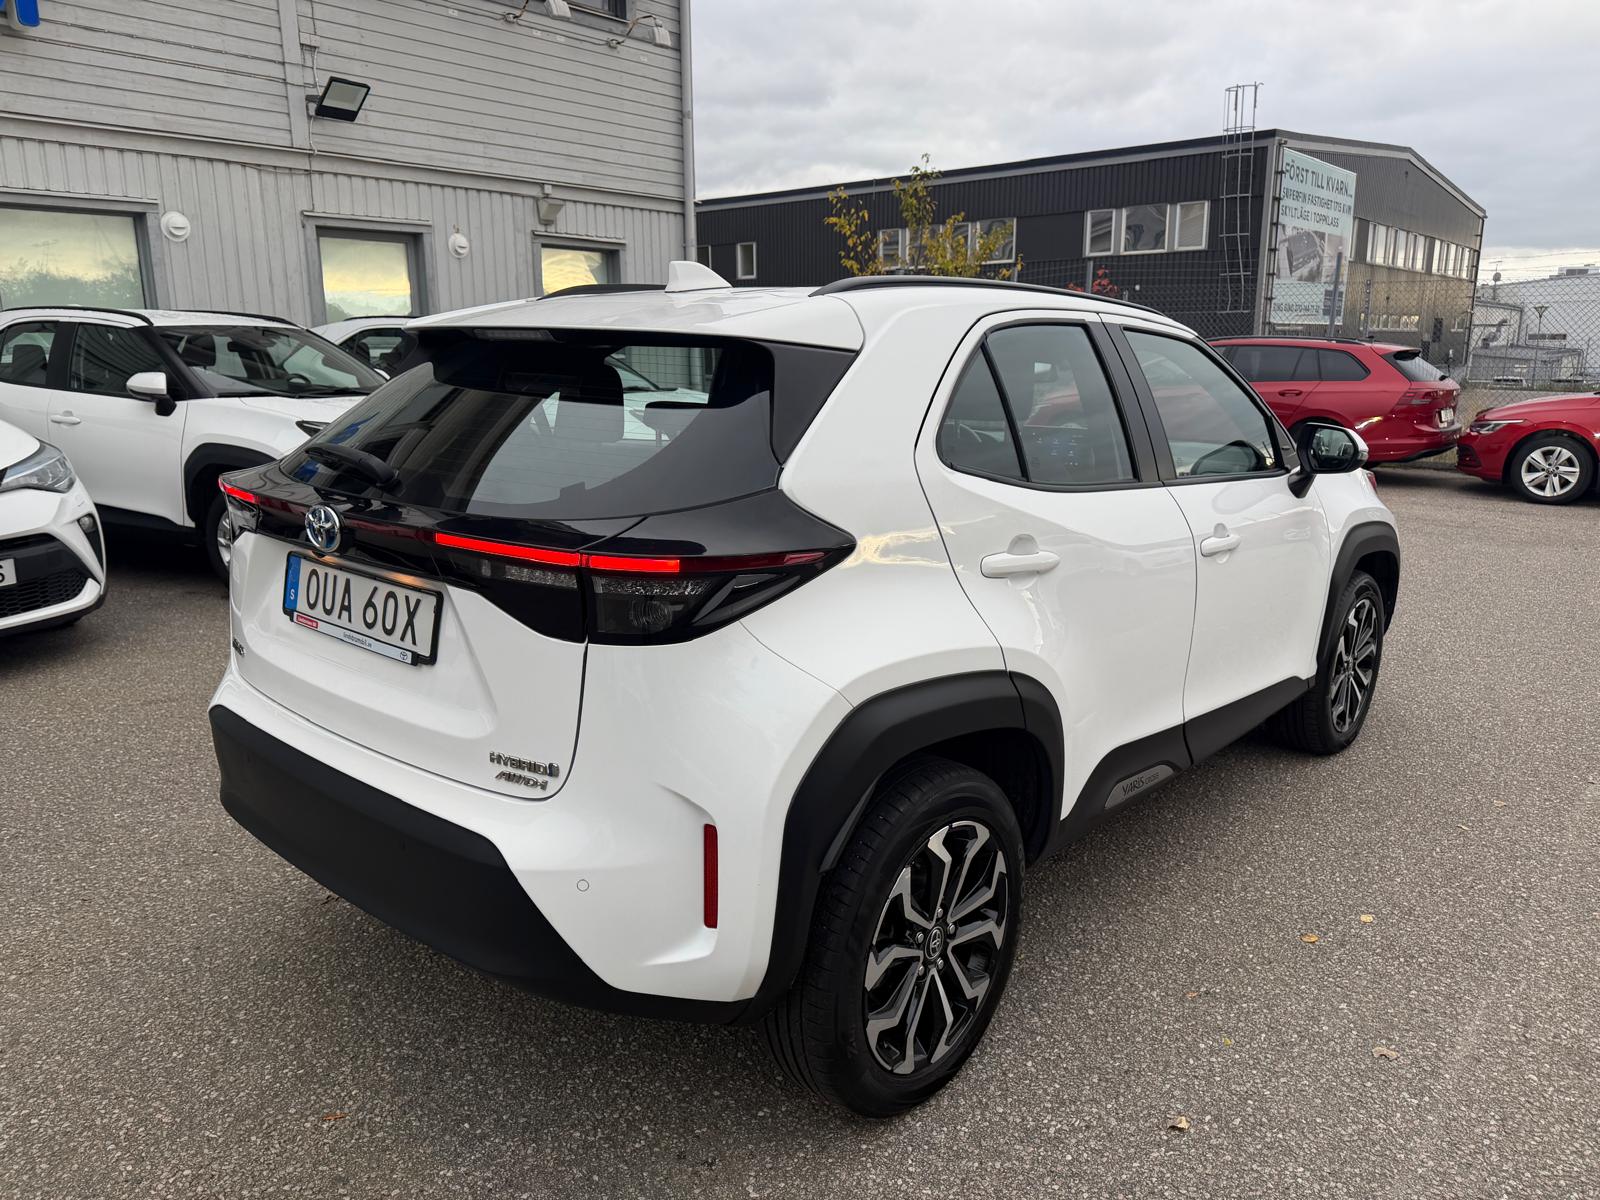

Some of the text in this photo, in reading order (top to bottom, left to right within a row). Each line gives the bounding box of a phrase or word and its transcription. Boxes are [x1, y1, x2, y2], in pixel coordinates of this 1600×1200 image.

[1284, 159, 1309, 184] FÖRST
[1311, 171, 1324, 189] TILL
[1308, 193, 1333, 210] FASTIGHET
[1313, 212, 1339, 228] TOPPKLASS
[289, 588, 295, 600] S
[306, 568, 422, 646] OUA 60X
[489, 751, 548, 776] HYBRID
